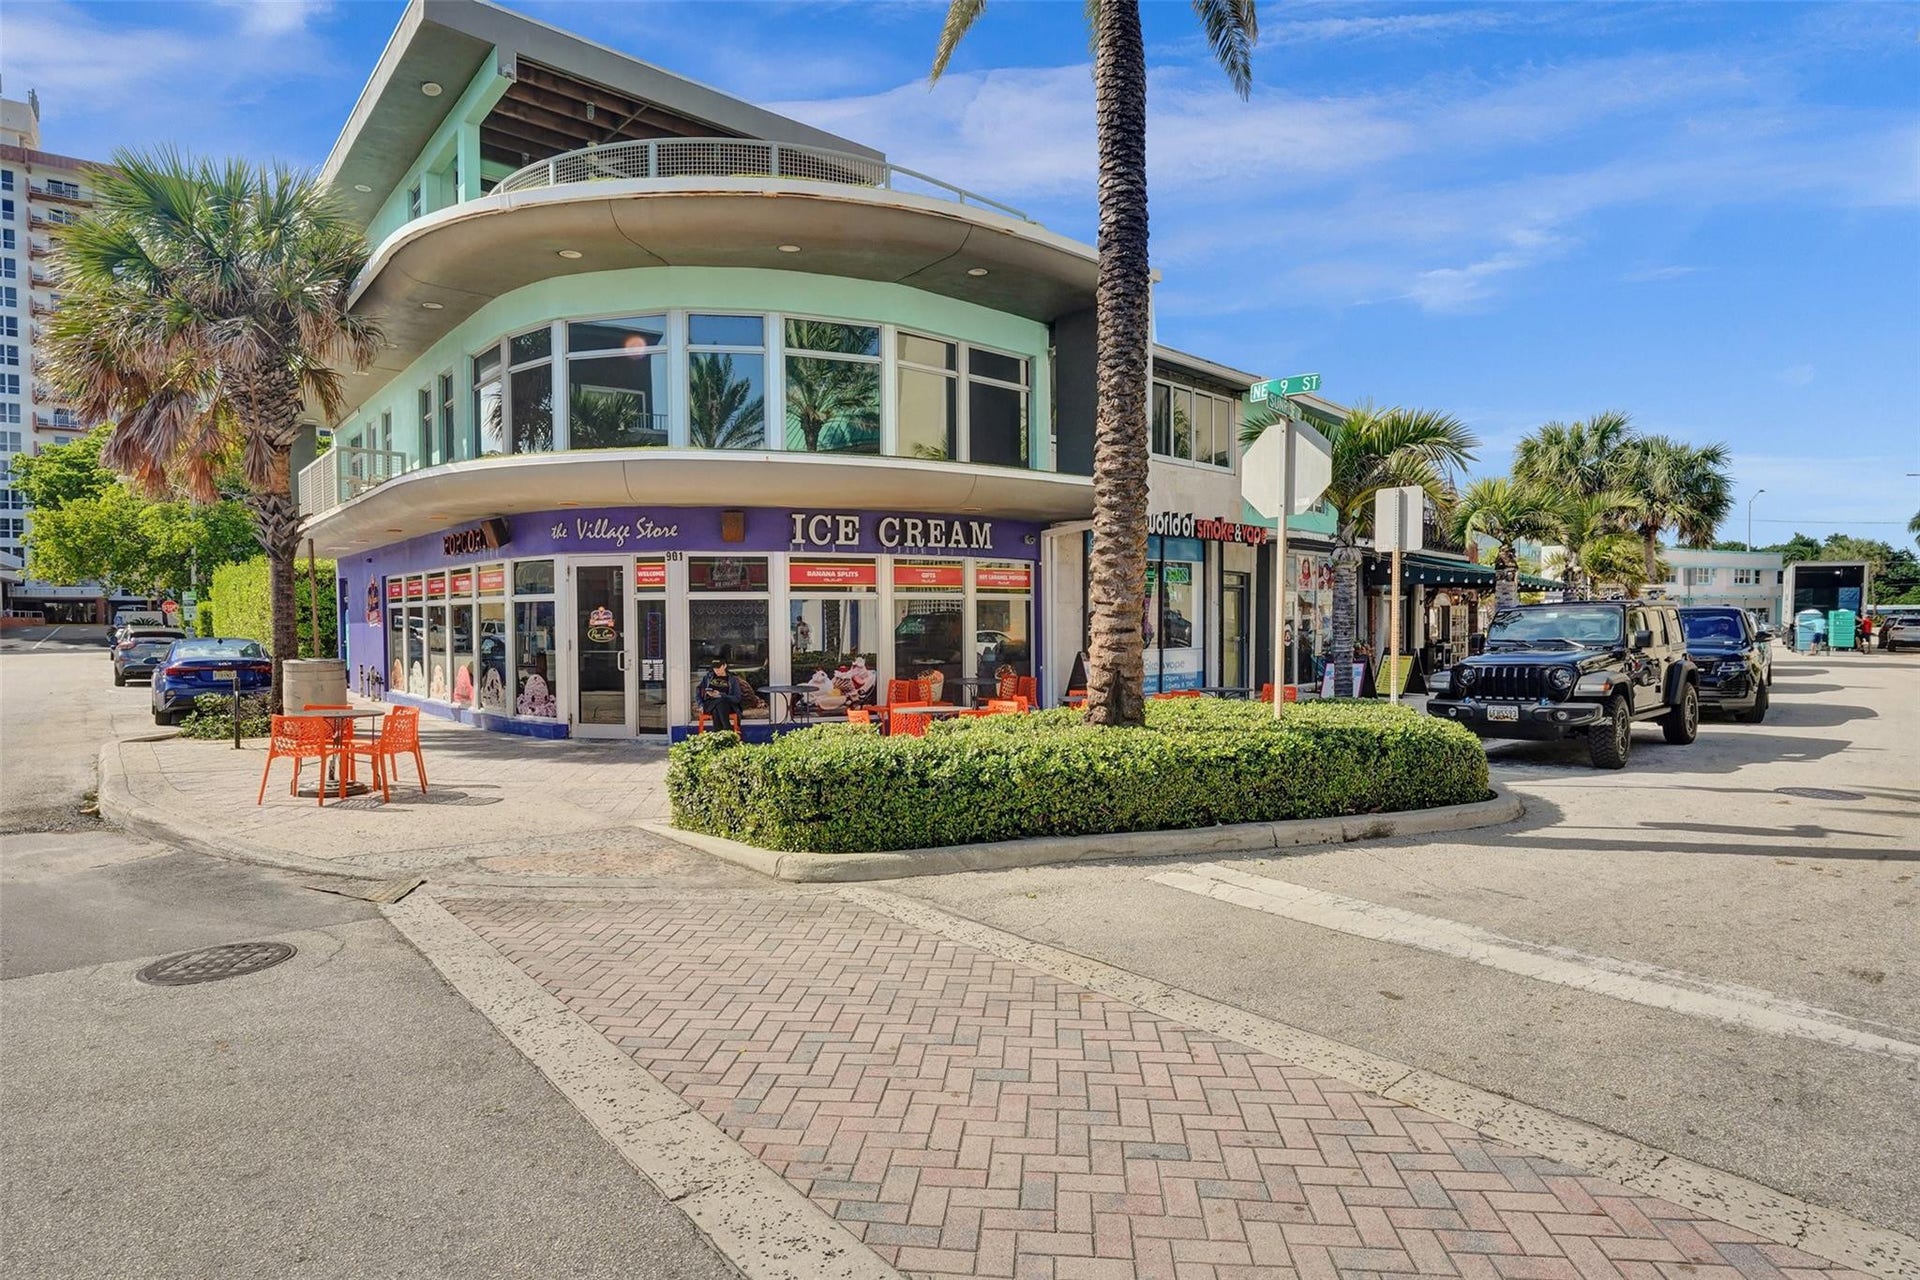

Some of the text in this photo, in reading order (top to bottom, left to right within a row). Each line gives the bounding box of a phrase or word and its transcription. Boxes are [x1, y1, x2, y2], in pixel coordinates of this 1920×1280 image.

[1253, 375, 1319, 400] NE 9 ST
[550, 516, 678, 547] the Village Store
[791, 513, 993, 550] ICE CREAM
[1182, 513, 1196, 538] of
[1196, 517, 1235, 542] smoke
[665, 551, 683, 562] 901
[637, 570, 665, 578] WELCOME
[806, 570, 859, 578] BANANA SPLITS
